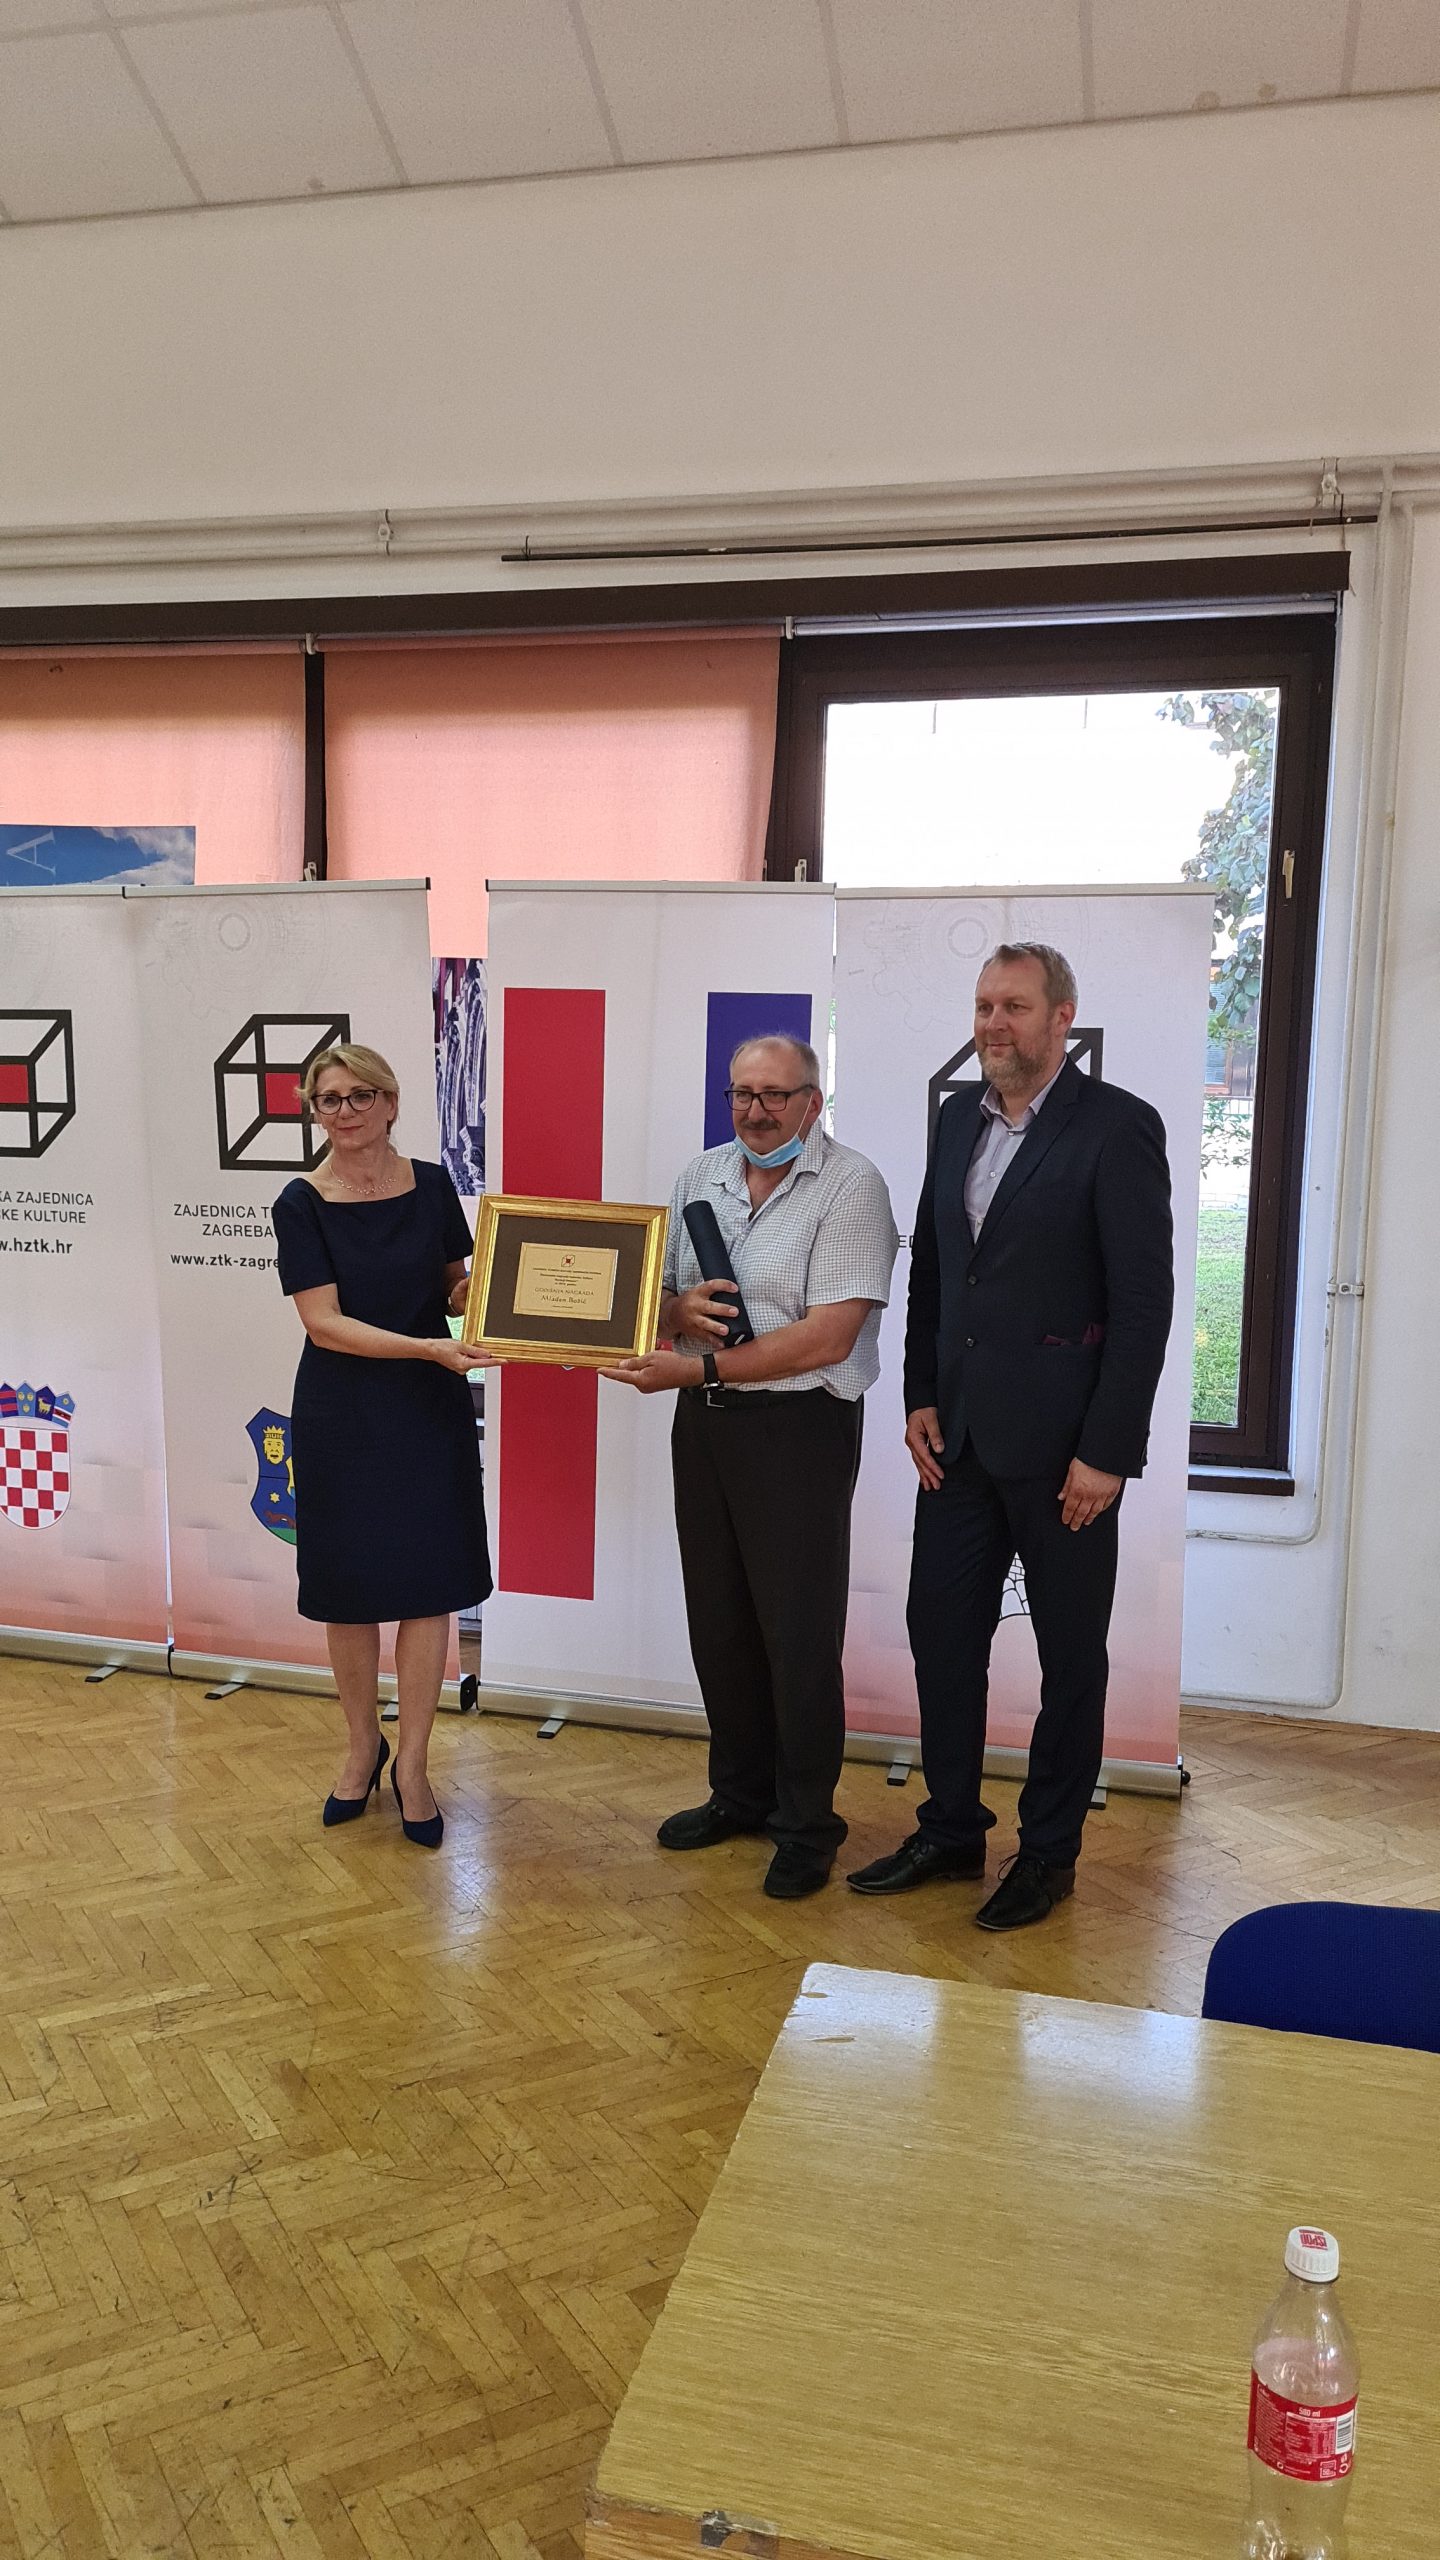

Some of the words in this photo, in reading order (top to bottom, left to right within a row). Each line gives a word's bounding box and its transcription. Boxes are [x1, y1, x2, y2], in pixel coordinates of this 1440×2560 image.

[16, 1191, 94, 1206] ZAJEDNICA
[24, 1209, 86, 1224] KULTURE
[174, 1203, 256, 1219] ZAJEDNICA
